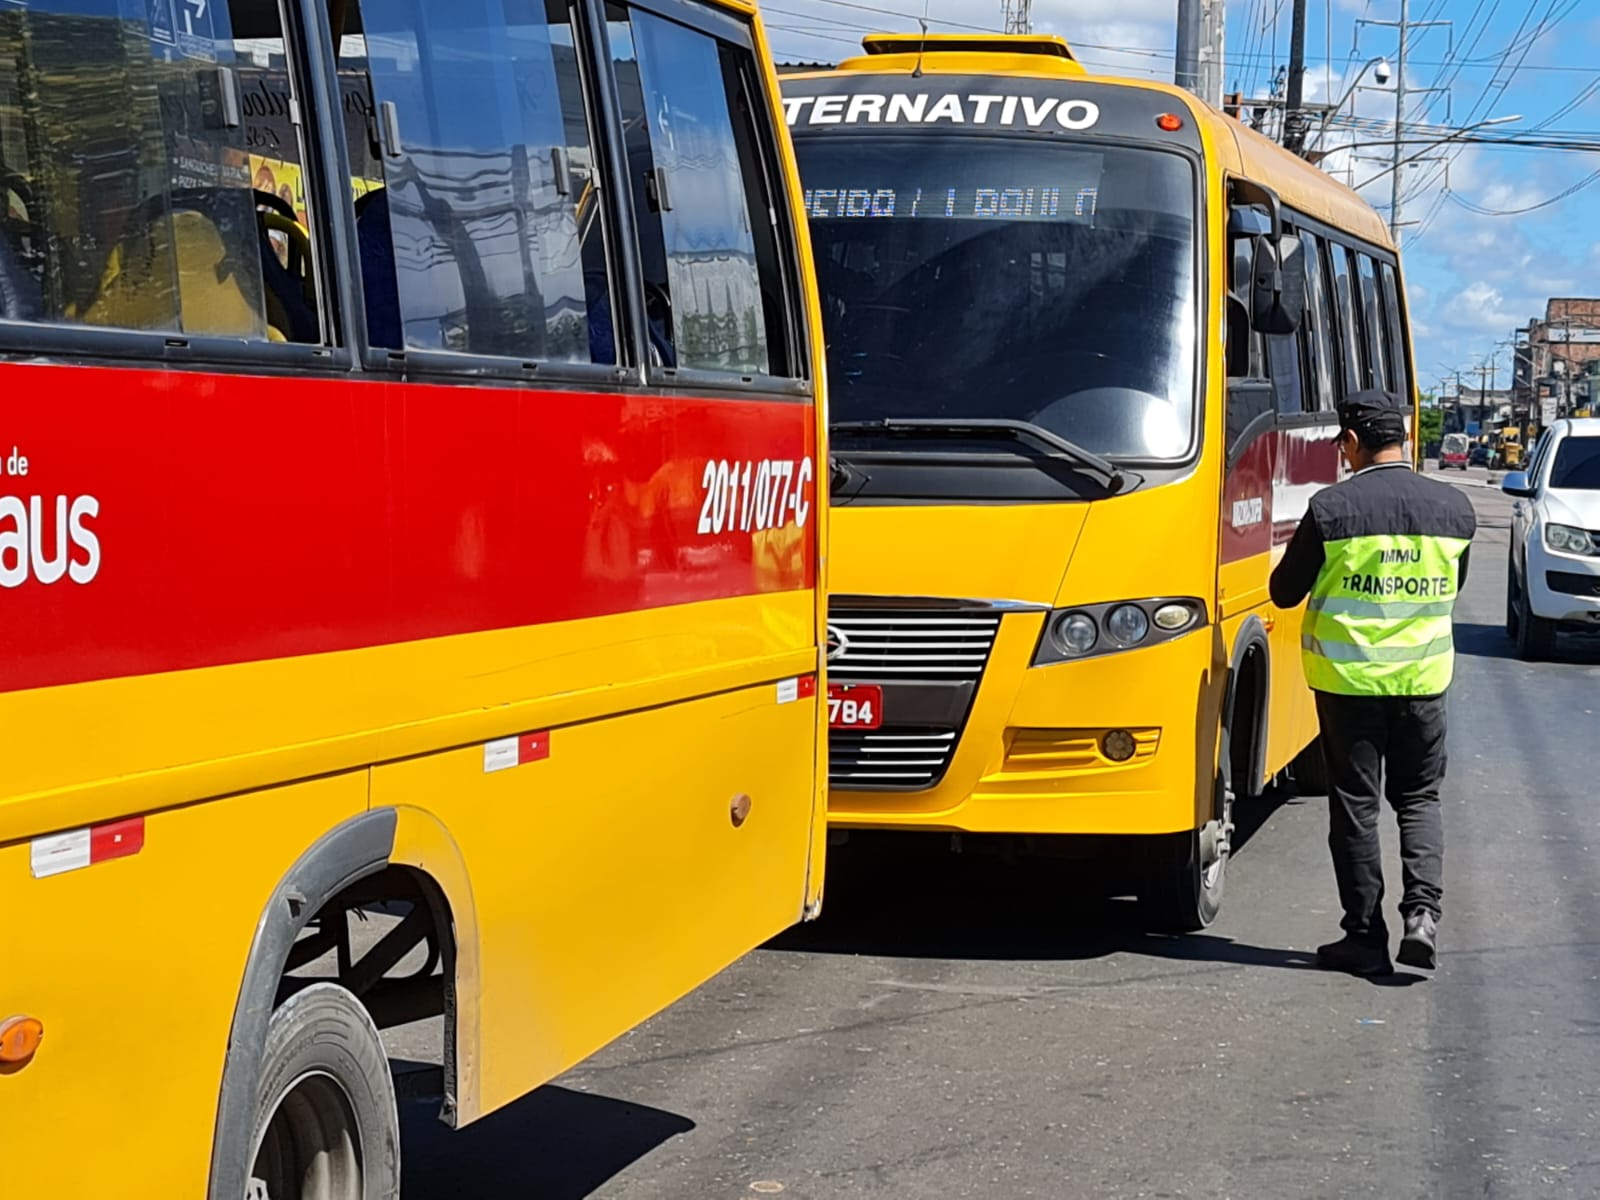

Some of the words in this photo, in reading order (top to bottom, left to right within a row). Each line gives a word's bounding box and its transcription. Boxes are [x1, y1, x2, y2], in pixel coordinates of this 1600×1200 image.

[783, 94, 1100, 130] TERNATIVO
[7, 445, 29, 475] de
[697, 456, 812, 535] 2011/077-C
[0, 494, 101, 588] aus
[1380, 549, 1421, 564] IMMU
[1342, 573, 1449, 597] TRANSPORTE
[827, 699, 874, 724] 784
